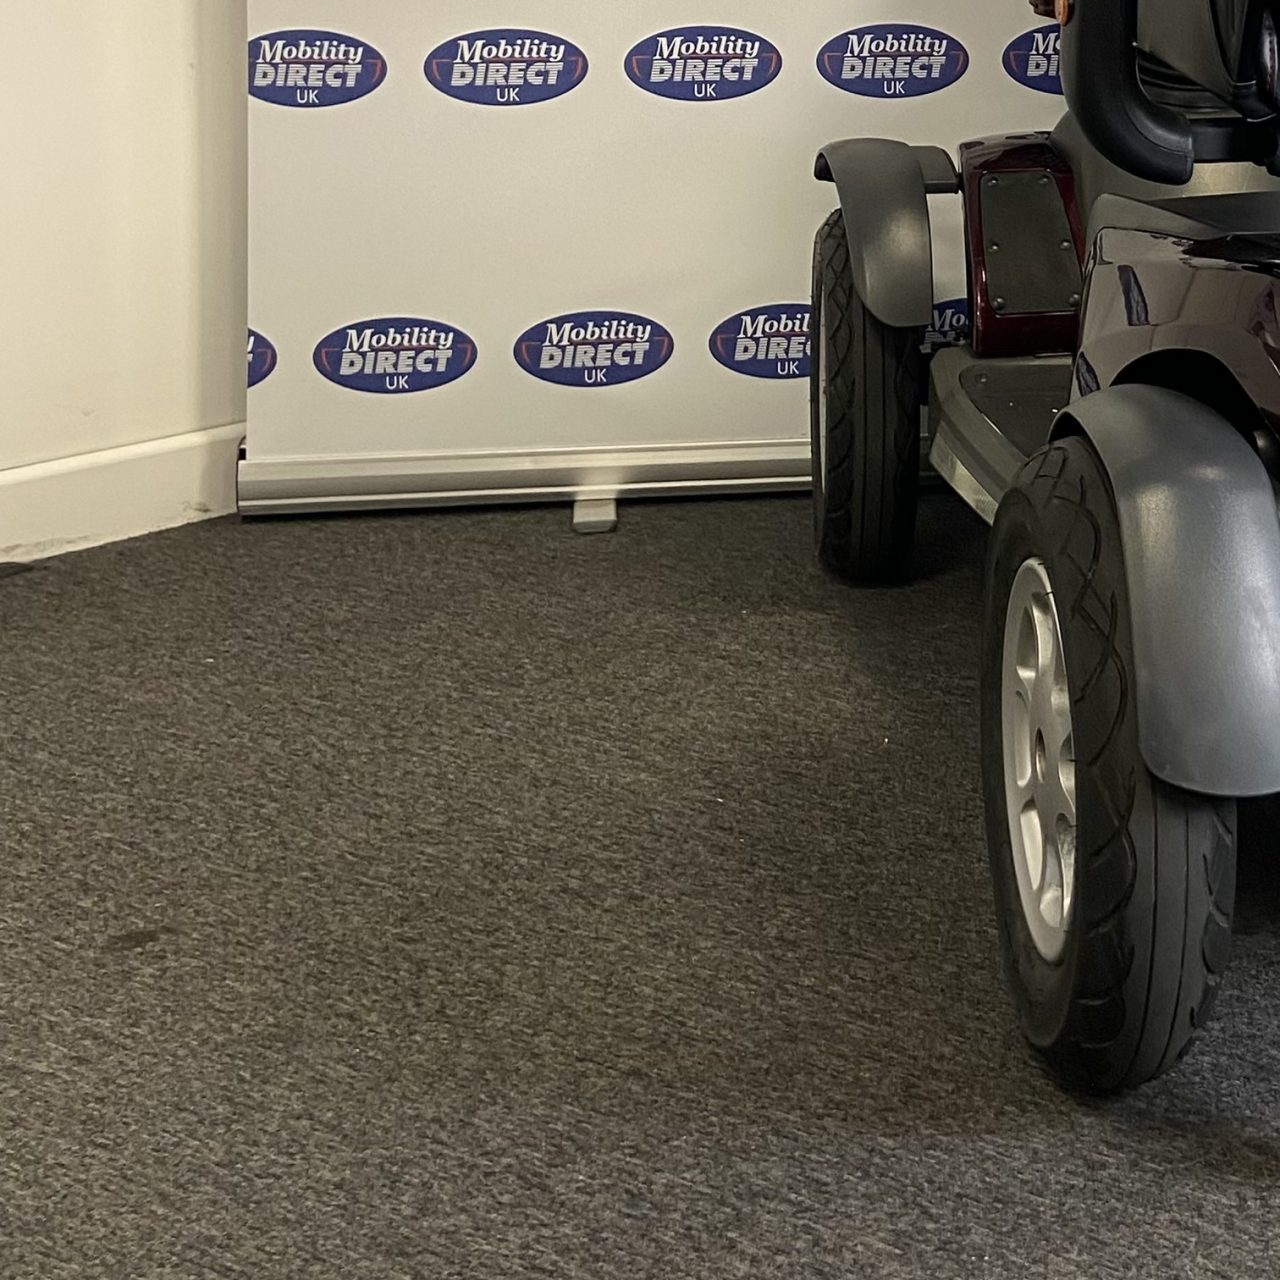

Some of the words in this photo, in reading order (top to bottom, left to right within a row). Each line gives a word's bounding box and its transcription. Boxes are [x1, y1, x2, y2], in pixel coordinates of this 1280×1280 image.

[255, 39, 364, 65] Mobility
[452, 38, 566, 64] Mobility
[652, 35, 760, 60] Mobility
[843, 33, 948, 57] Mobility
[253, 63, 363, 88] DIRECT
[450, 61, 564, 87] DIRECT
[649, 58, 759, 83] DIRECT
[840, 56, 947, 80] DIRECT
[296, 88, 319, 104] UK
[496, 87, 520, 102] UK
[694, 83, 717, 98] UK
[883, 80, 905, 95] UK
[341, 326, 454, 353] Mobility
[541, 319, 652, 347] Mobility
[339, 349, 453, 376] DIRECT
[539, 341, 650, 369] DIRECT
[777, 360, 800, 375] UK
[385, 375, 409, 390] UK
[584, 368, 607, 384] UK
